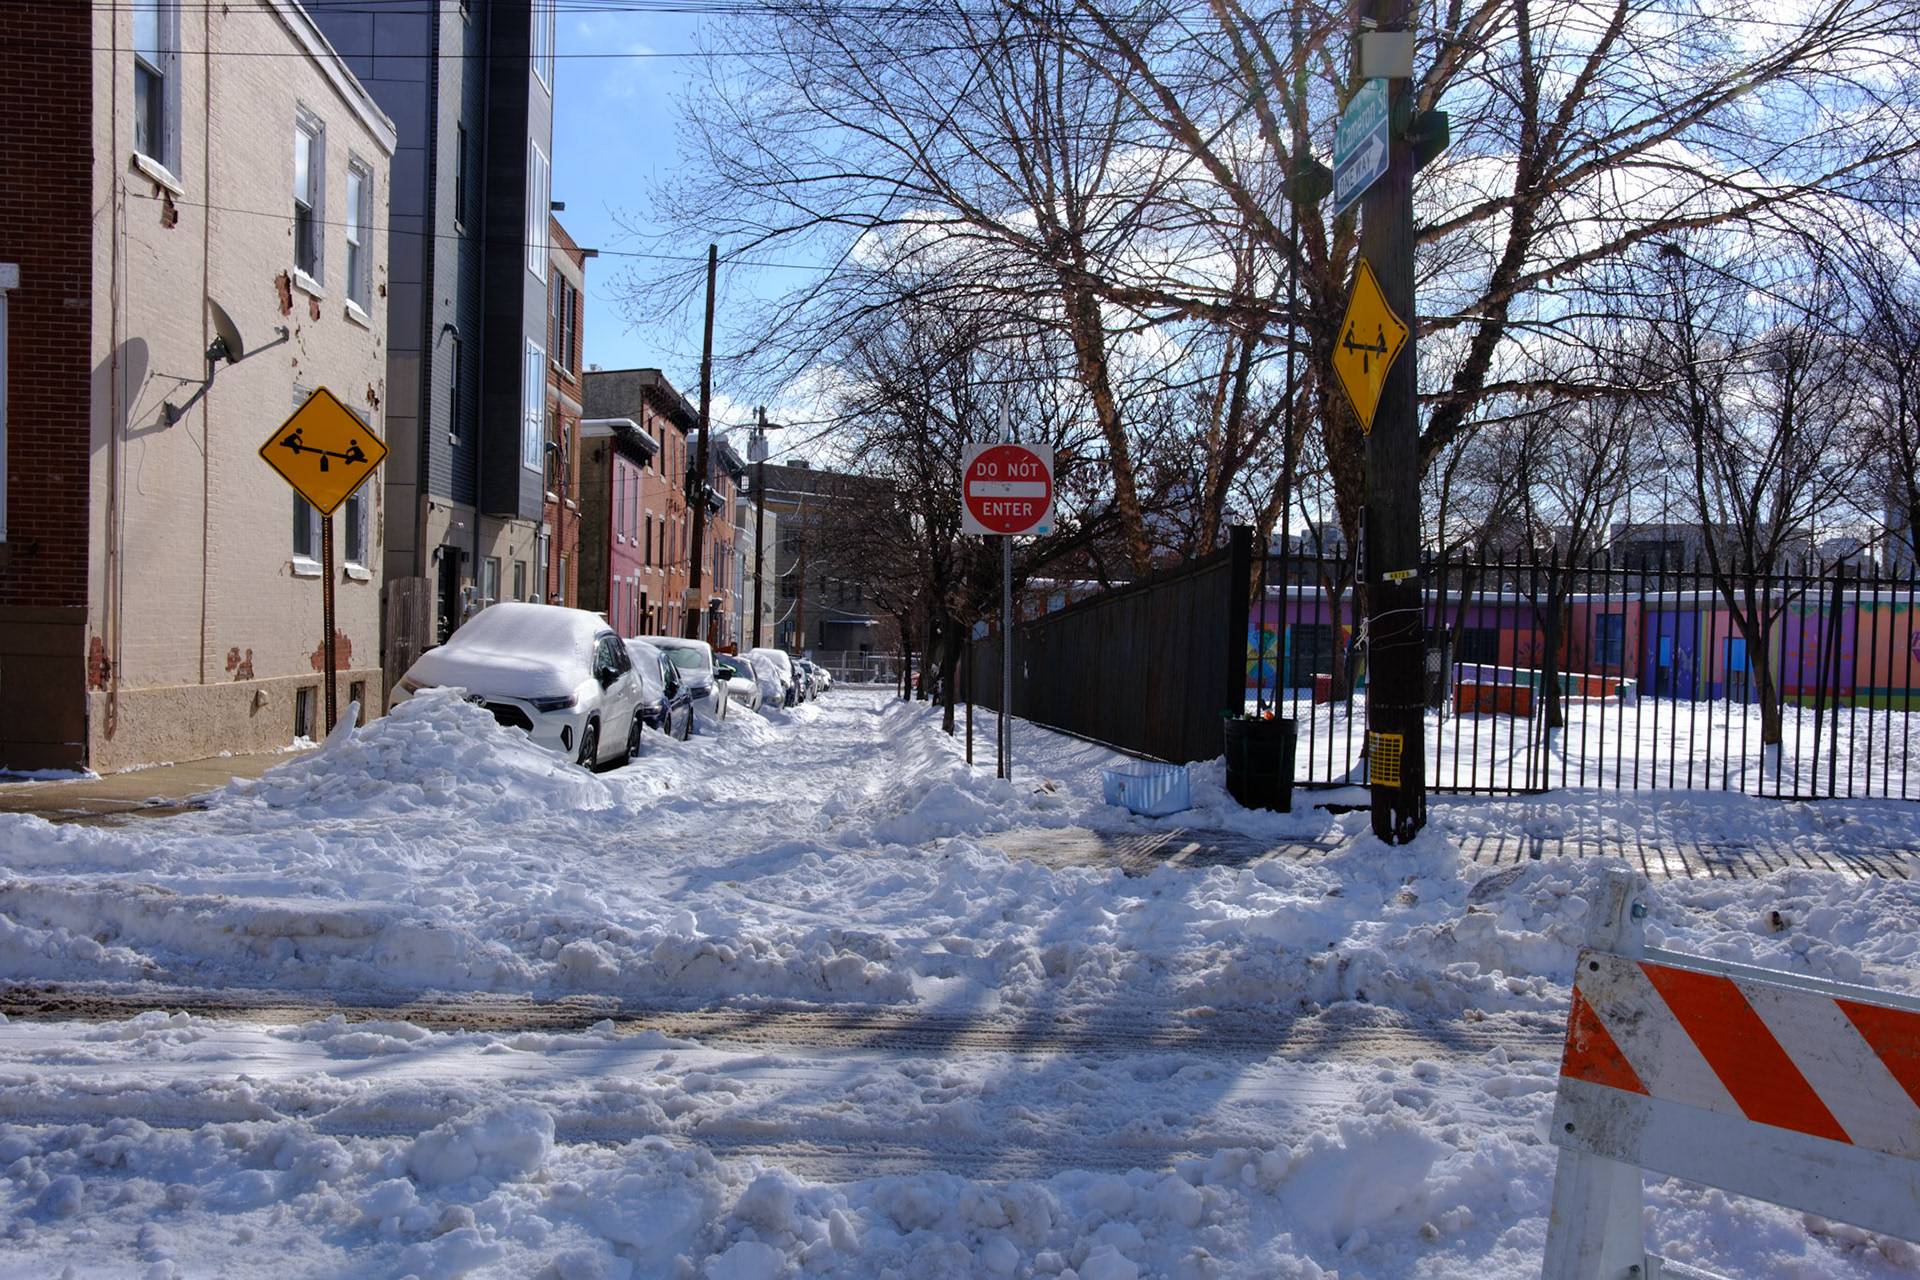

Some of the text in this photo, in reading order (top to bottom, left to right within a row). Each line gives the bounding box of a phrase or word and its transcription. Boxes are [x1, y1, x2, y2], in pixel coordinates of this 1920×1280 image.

[1341, 100, 1376, 154] Cameron
[1375, 86, 1386, 113] St
[1339, 149, 1372, 196] ONE WAY
[977, 462, 1039, 477] DO NOT
[983, 502, 1033, 516] ENTER
